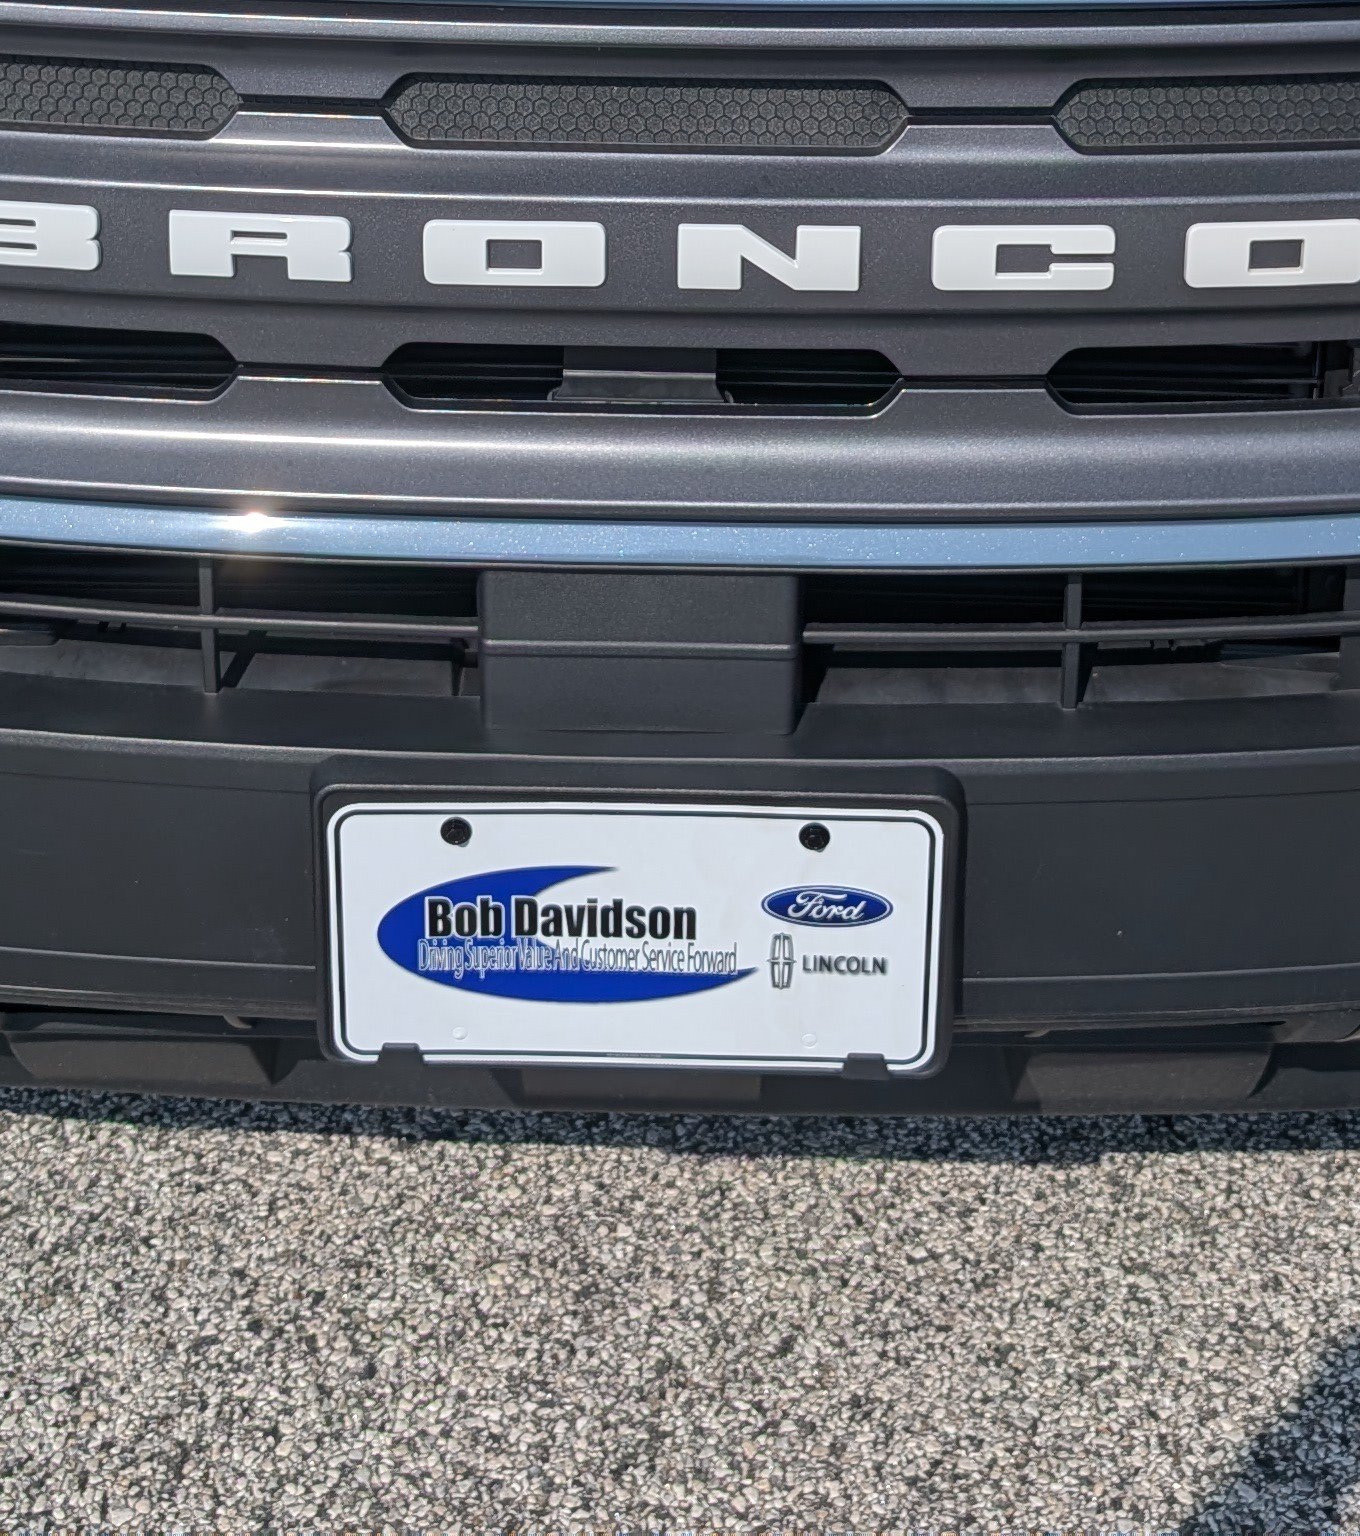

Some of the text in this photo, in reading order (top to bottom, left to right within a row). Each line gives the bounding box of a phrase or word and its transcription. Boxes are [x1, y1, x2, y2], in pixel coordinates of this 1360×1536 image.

[427, 897, 697, 939] Bob Davidson
[787, 891, 867, 920] Ford
[419, 939, 738, 979] Driving Superior Value And Customer Service Forward
[802, 954, 887, 975] LINCOLN
